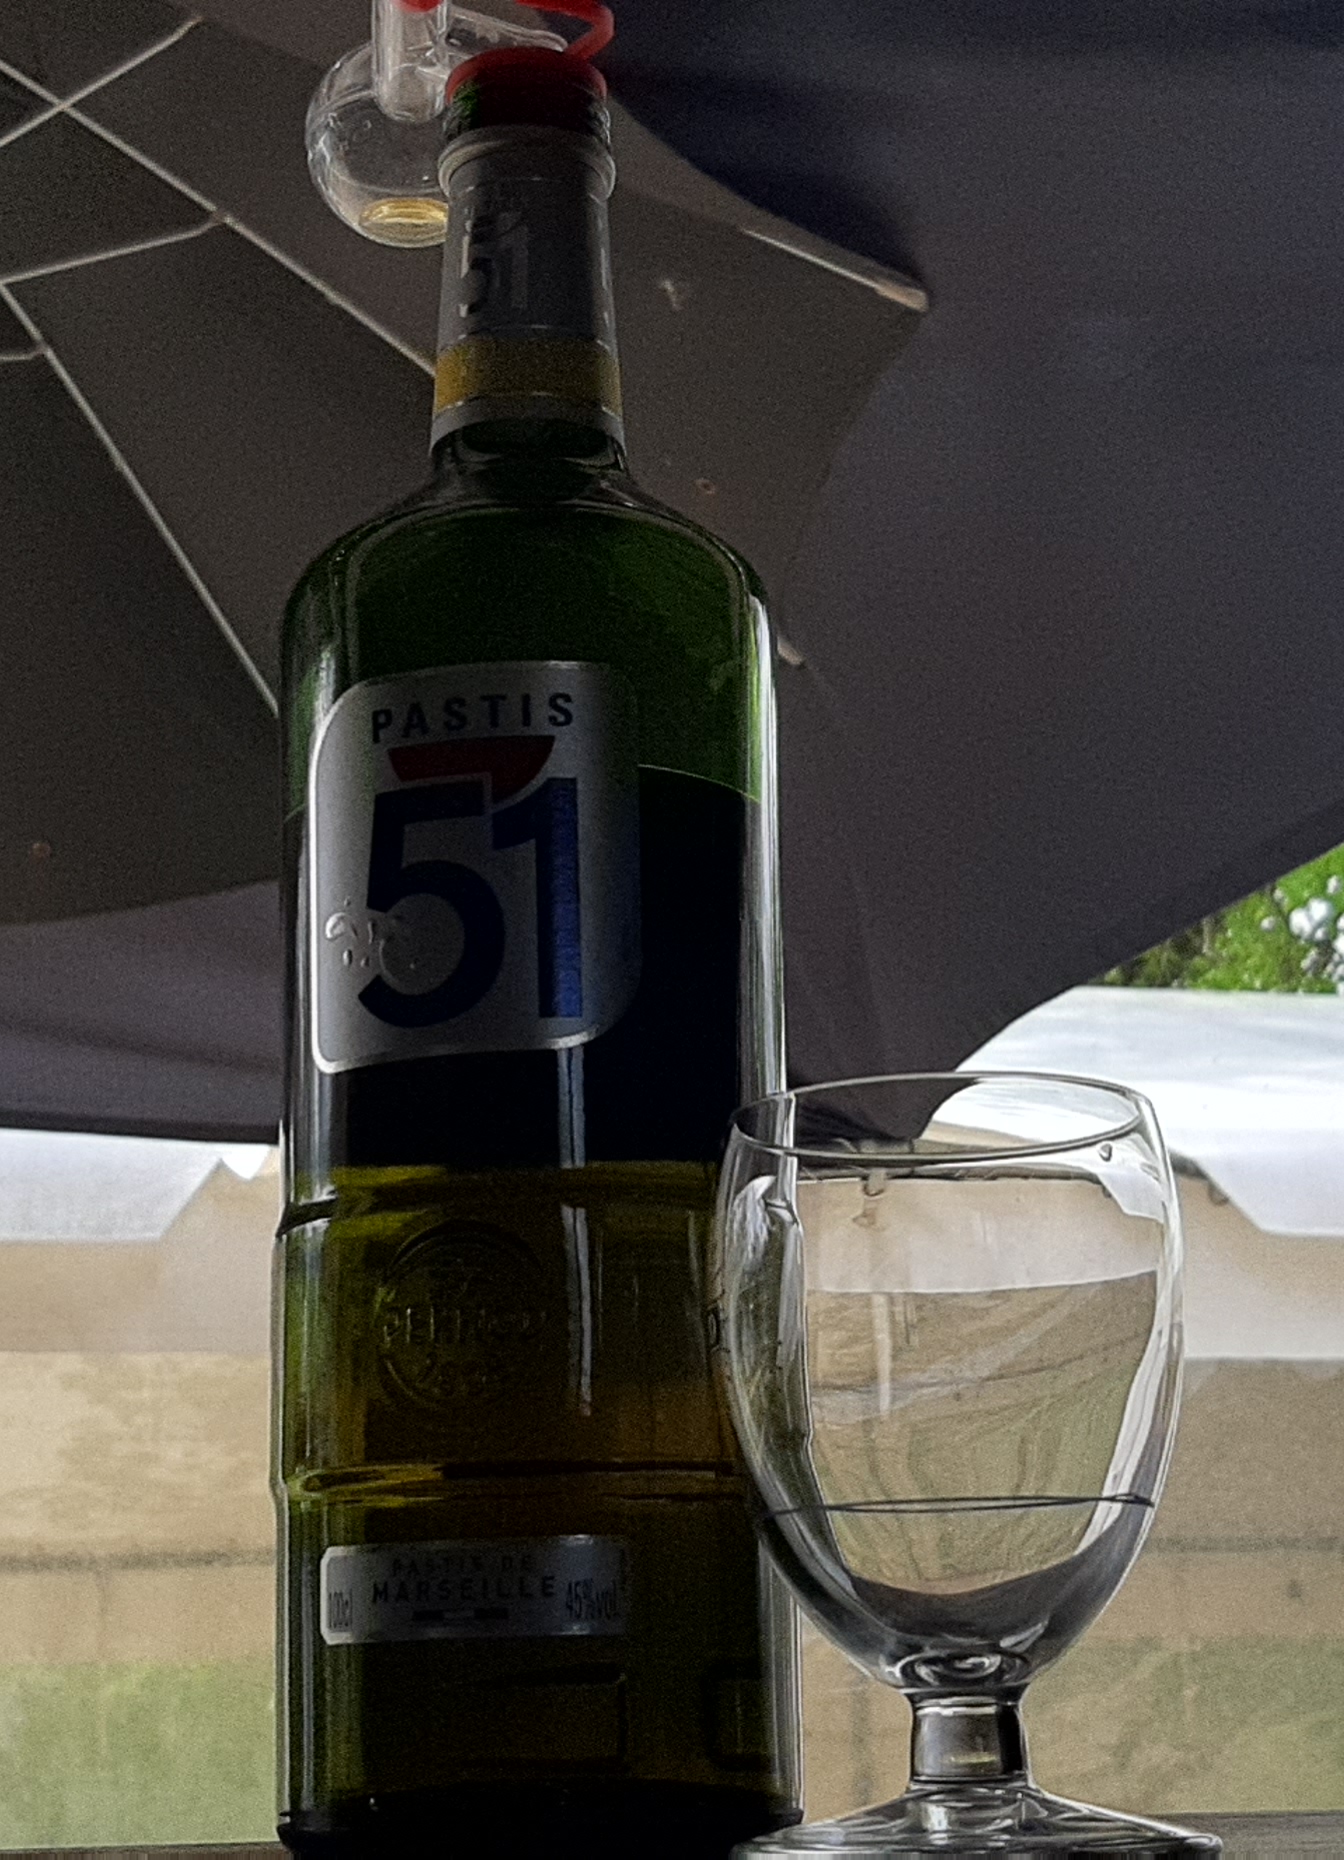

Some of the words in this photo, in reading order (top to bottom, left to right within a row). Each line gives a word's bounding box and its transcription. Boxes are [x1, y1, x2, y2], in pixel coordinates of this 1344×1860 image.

[371, 693, 574, 743] PASTIS
[358, 777, 583, 1028] 51
[391, 1554, 483, 1577] PASTIS
[500, 1553, 534, 1573] DE
[371, 1575, 556, 1604] MARSEILLE
